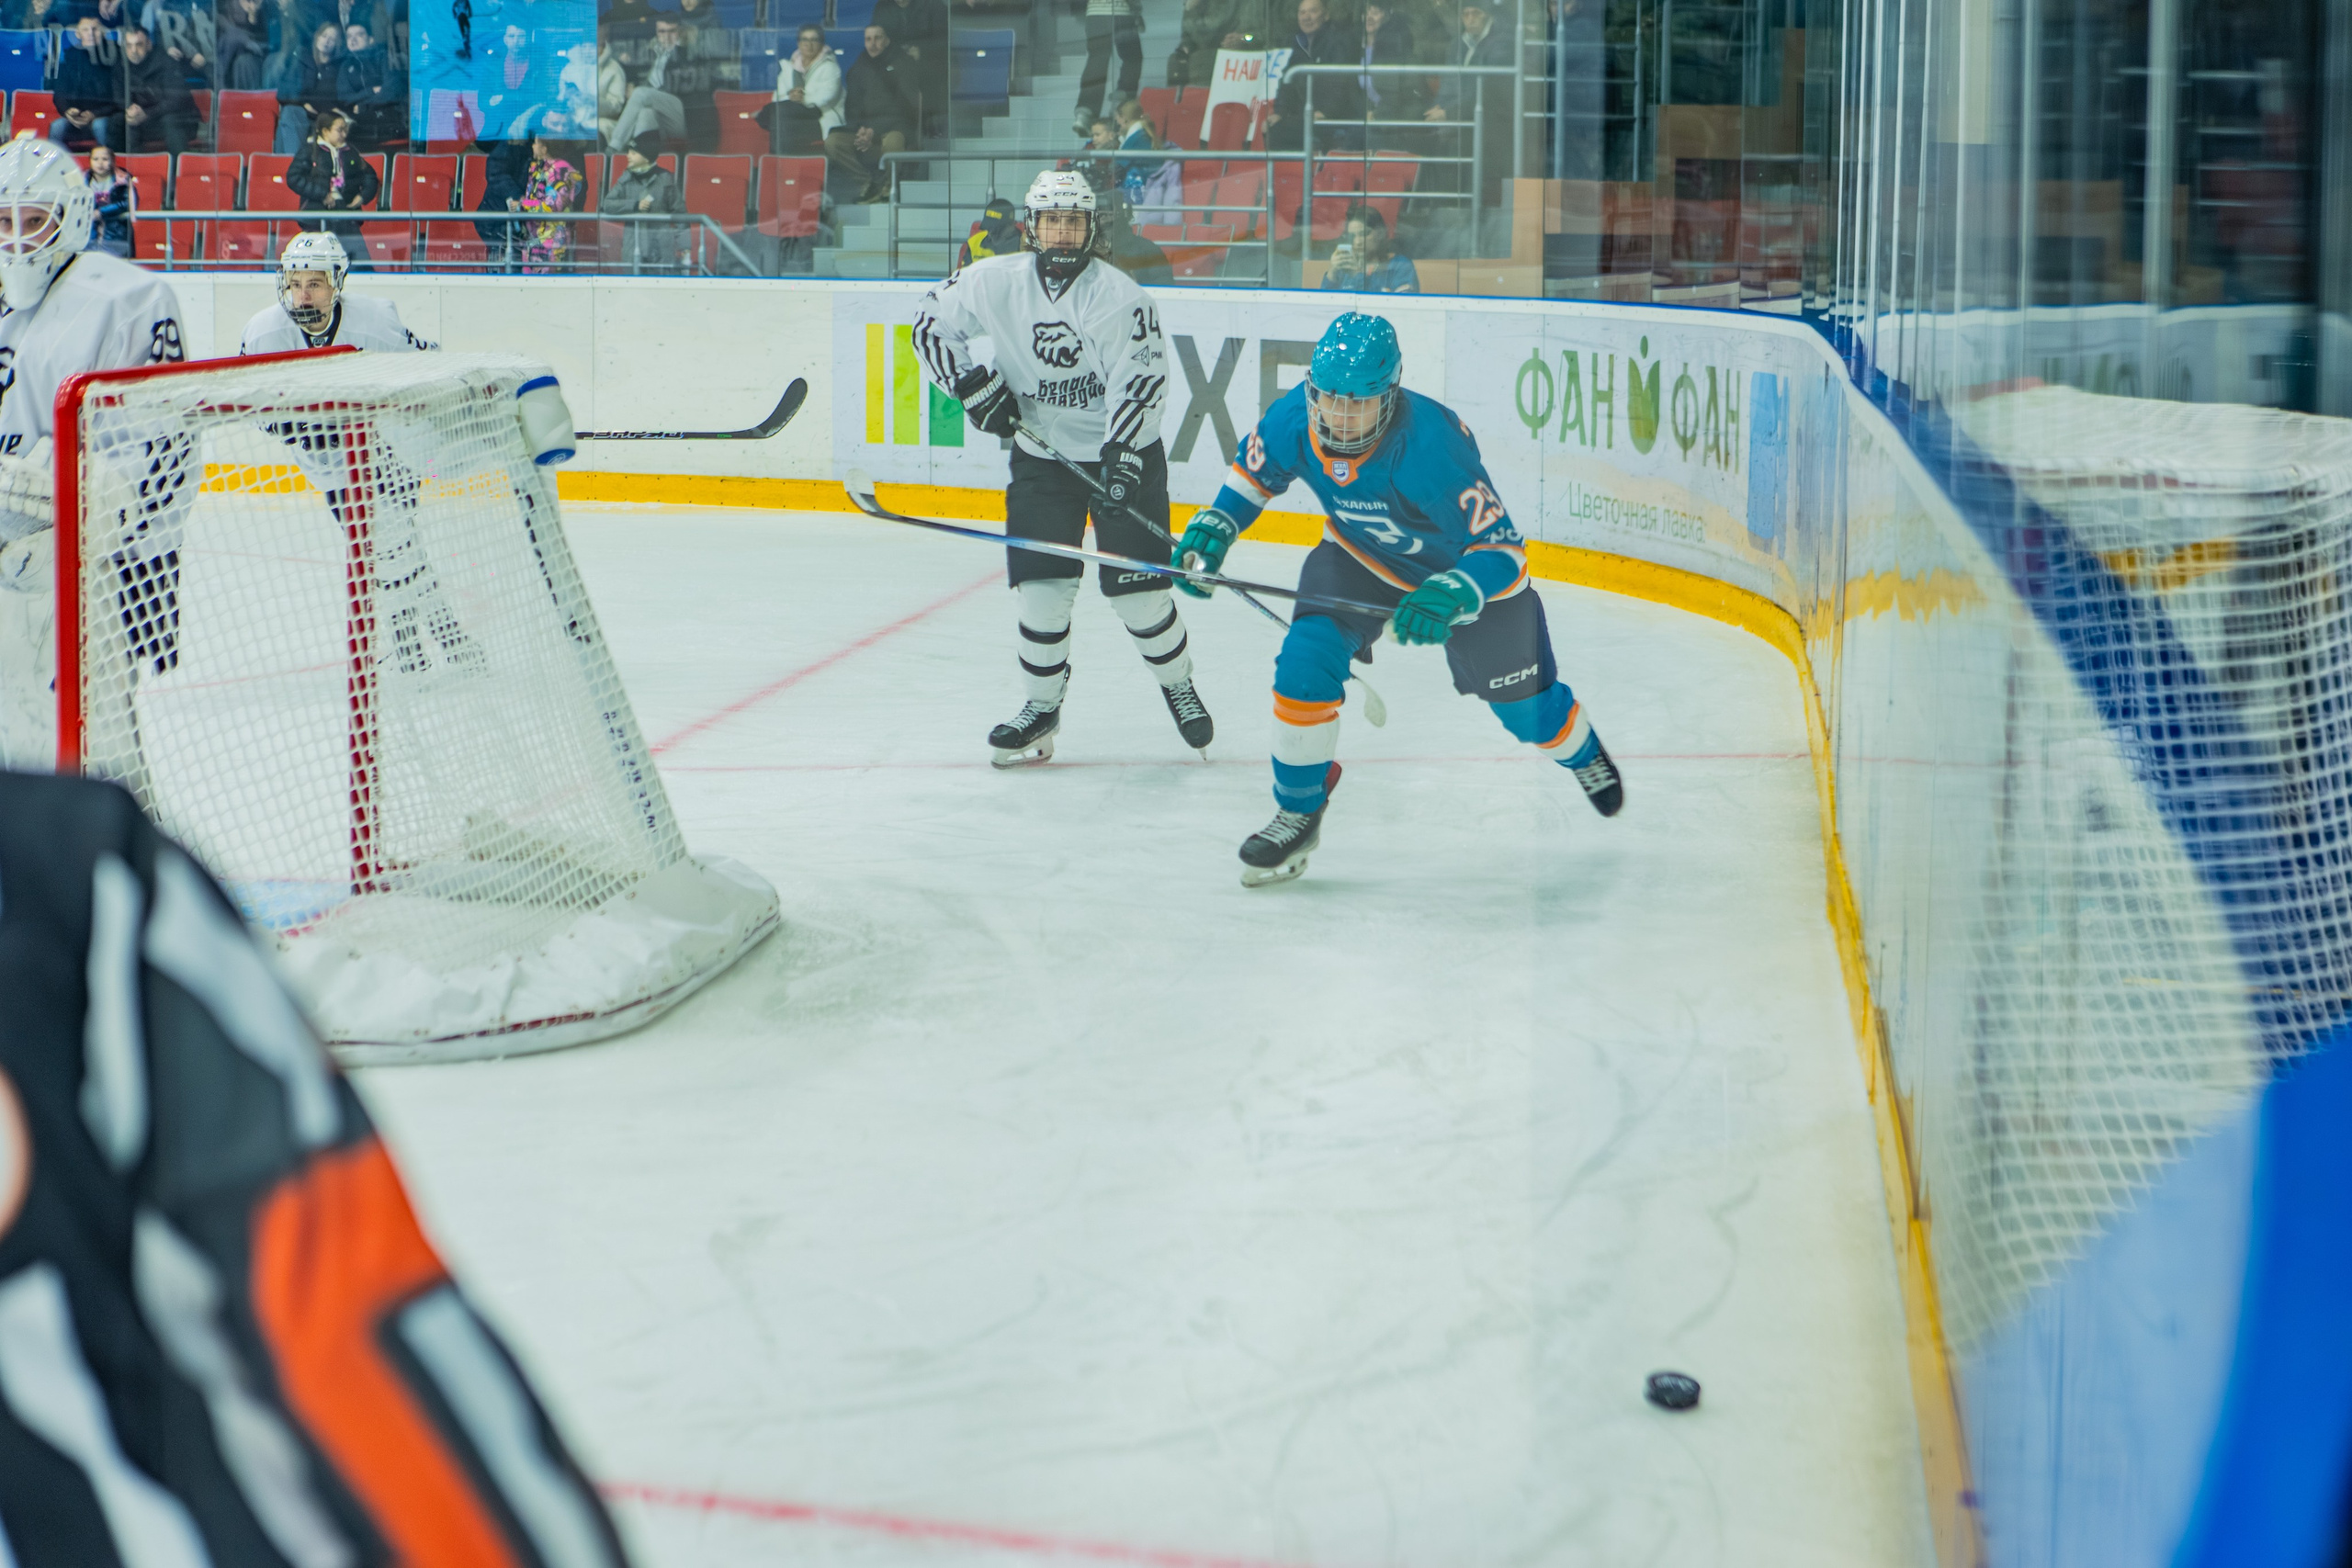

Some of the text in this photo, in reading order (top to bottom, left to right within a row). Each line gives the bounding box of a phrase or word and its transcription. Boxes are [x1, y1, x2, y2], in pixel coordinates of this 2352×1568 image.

[1131, 305, 1161, 342] 34
[962, 374, 1004, 411] WARRIO
[1516, 347, 1741, 475] ФАН ФАН
[1119, 452, 1144, 472] WAR
[1569, 481, 1704, 544] Цветочная лавка
[1117, 571, 1161, 583] CCM
[1489, 663, 1538, 689] CCM
